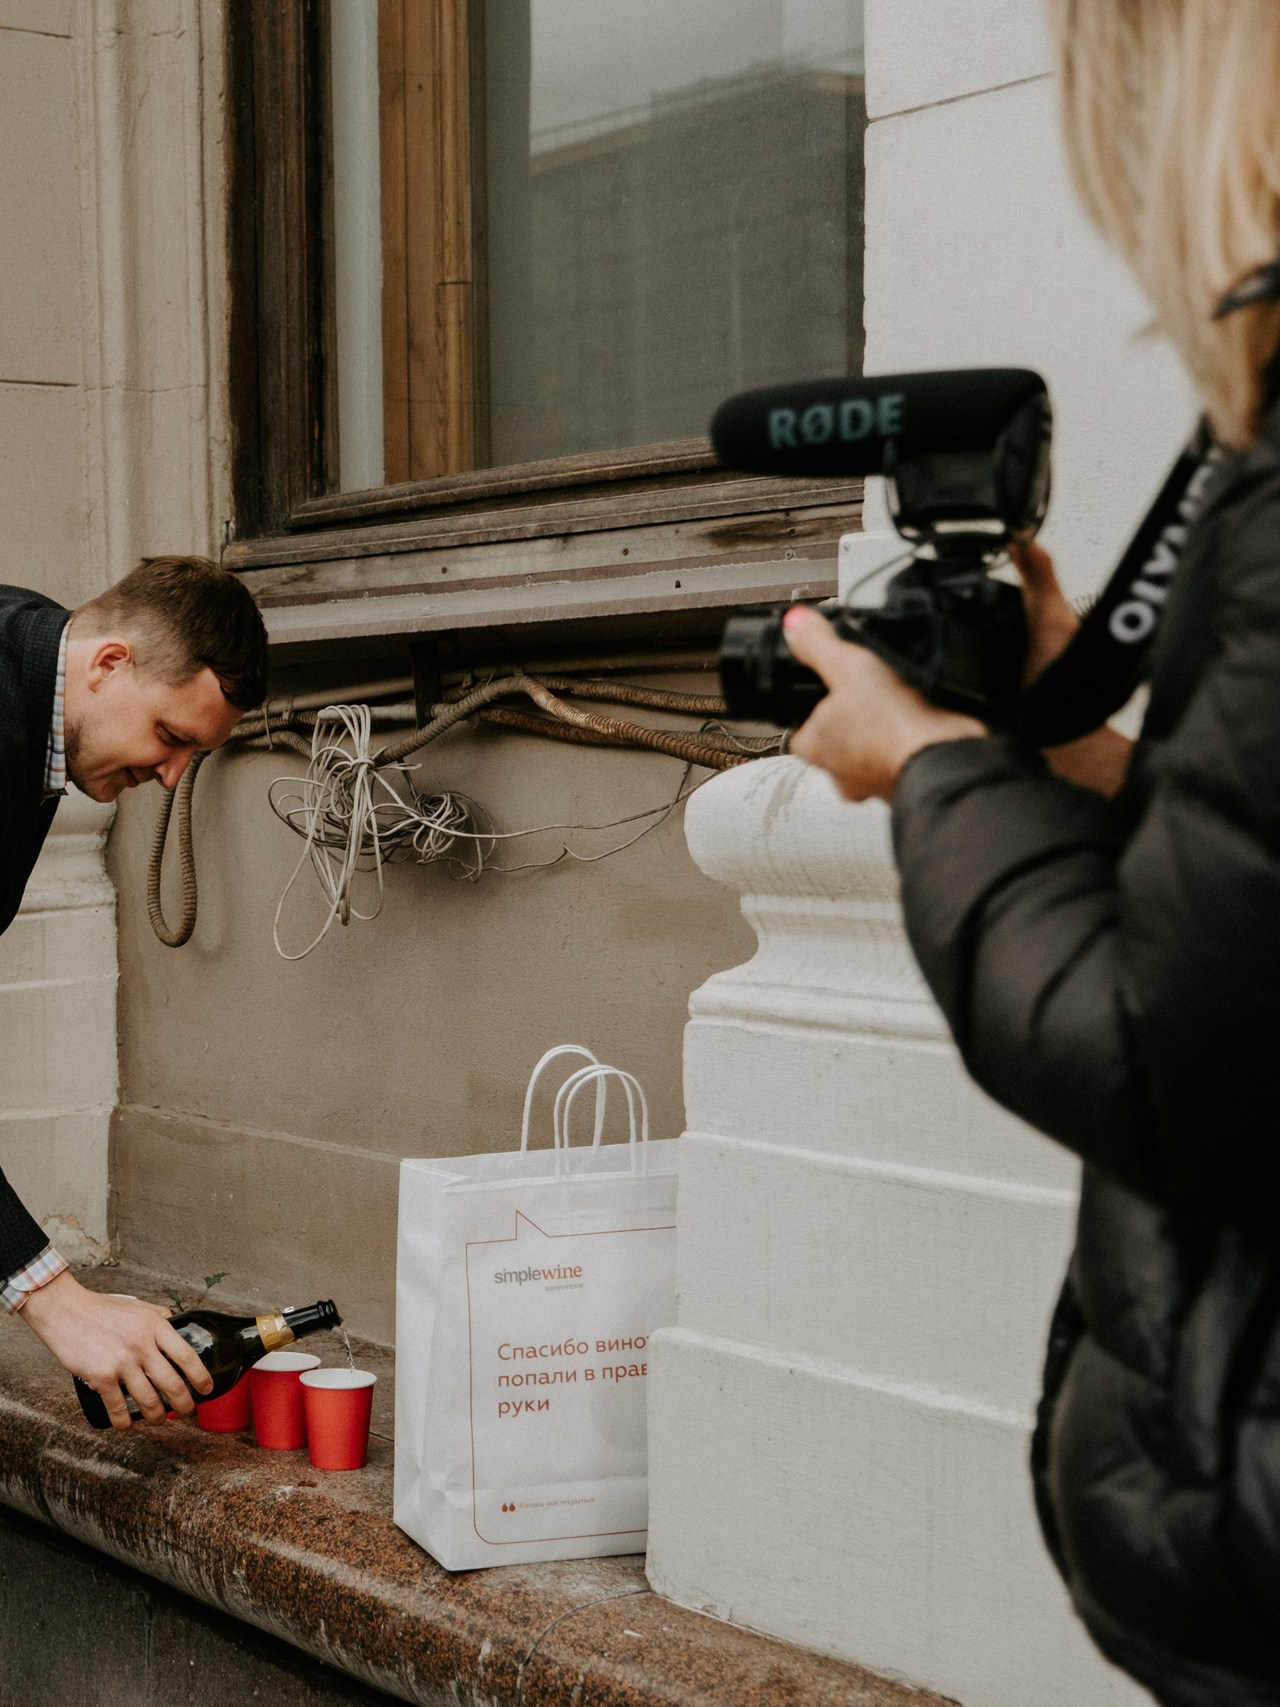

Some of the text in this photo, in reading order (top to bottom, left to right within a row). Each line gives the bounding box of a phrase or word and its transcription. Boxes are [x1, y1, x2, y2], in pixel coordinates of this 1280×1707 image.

[494, 1264, 583, 1286] simplewine
[497, 1336, 649, 1361] Спасибо вино
[498, 1370, 577, 1388] попали
[584, 1368, 596, 1381] в
[498, 1399, 550, 1418] руки
